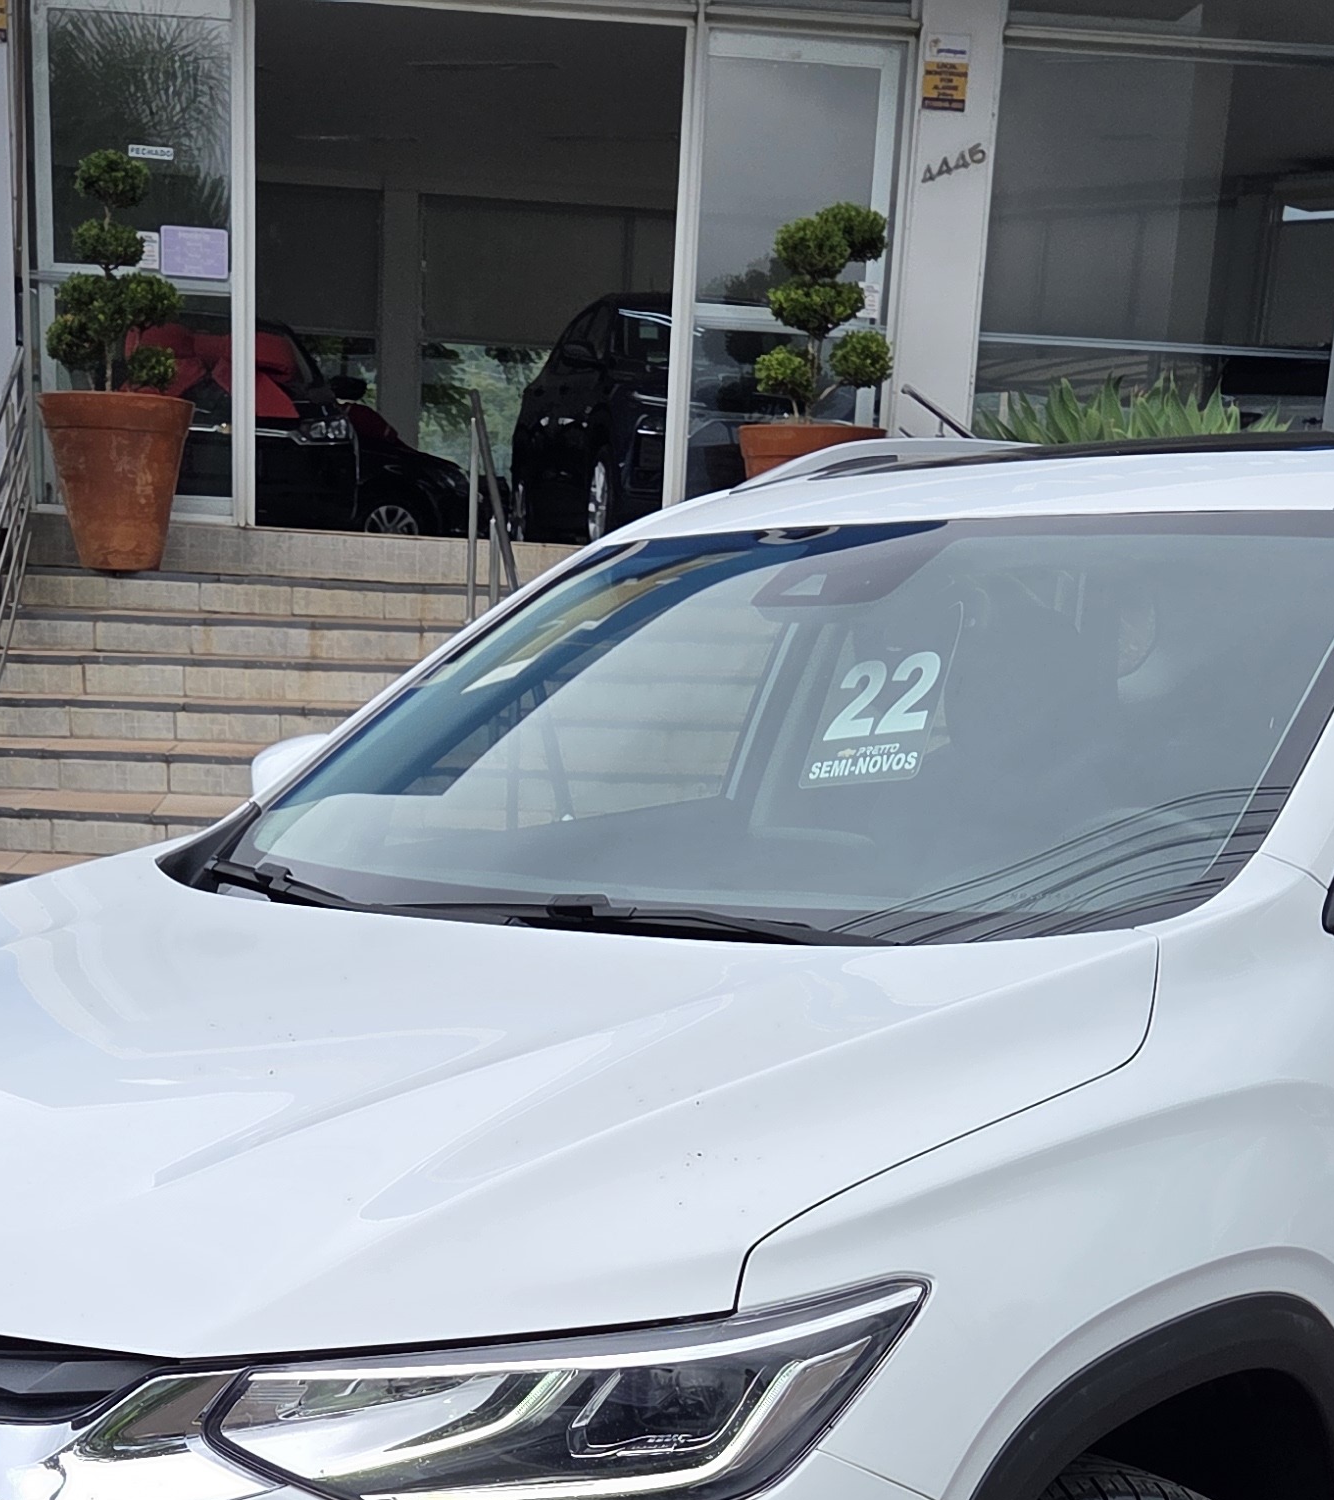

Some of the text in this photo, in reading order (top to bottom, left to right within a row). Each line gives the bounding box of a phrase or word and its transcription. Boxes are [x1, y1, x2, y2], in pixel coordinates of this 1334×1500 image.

[823, 651, 941, 741] 22
[857, 743, 900, 757] PRETTO
[808, 752, 918, 780] SEMI-NOVOS
